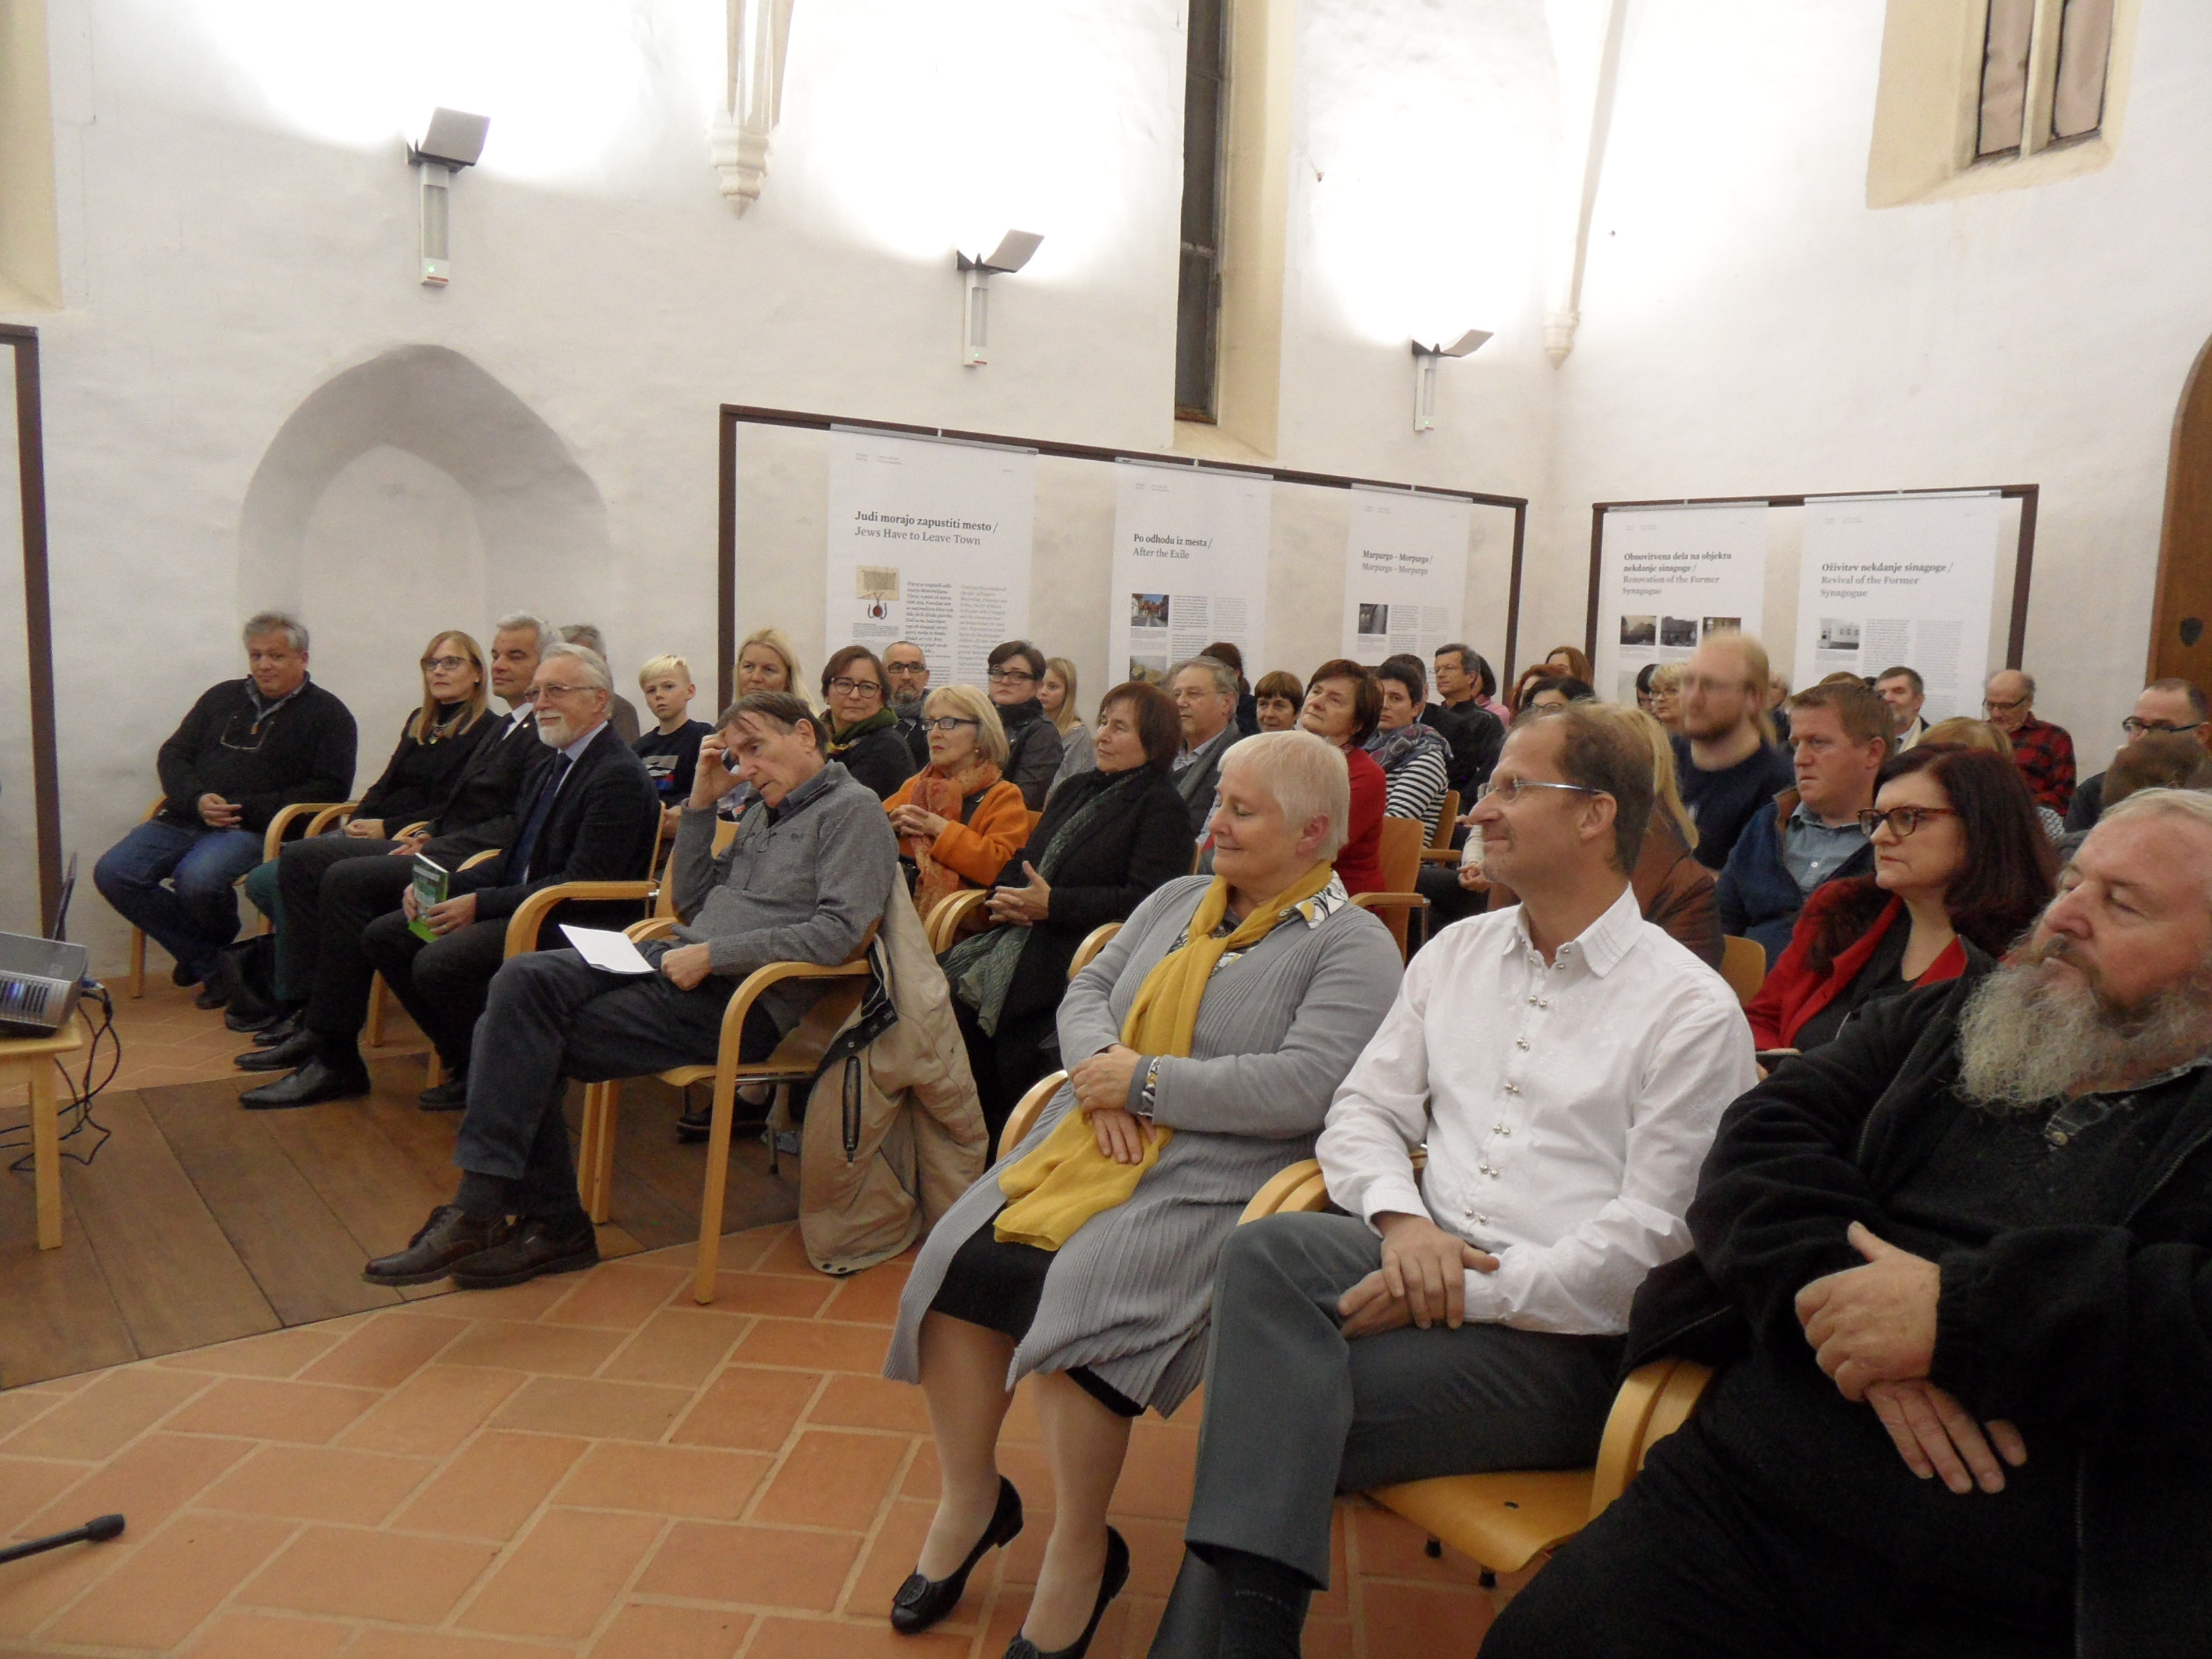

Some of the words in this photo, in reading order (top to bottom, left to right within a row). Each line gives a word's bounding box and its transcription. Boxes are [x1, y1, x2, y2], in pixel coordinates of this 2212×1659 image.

[855, 511, 878, 521] Judi
[880, 514, 915, 527] morajo
[917, 518, 960, 529] zapustiti
[962, 522, 991, 531] mesto
[855, 527, 881, 537] Jews
[883, 529, 907, 539] Have
[909, 531, 920, 540] to
[922, 532, 951, 543] Leave
[954, 534, 981, 545] Town
[1134, 533, 1144, 542] Po
[1145, 534, 1174, 544] odhodu
[1176, 536, 1183, 545] iz
[1133, 547, 1154, 556] After
[1156, 548, 1168, 558] the
[1170, 550, 1189, 558] Exile
[1673, 551, 1688, 560] dela
[1702, 551, 1732, 561] objektu
[1623, 564, 1657, 573] nekdanje
[1658, 564, 1691, 573] sinagoge
[1860, 562, 1902, 573] nekdanje
[1904, 562, 1946, 573] sinagoge
[1855, 575, 1866, 583] of
[1867, 575, 1881, 583] the
